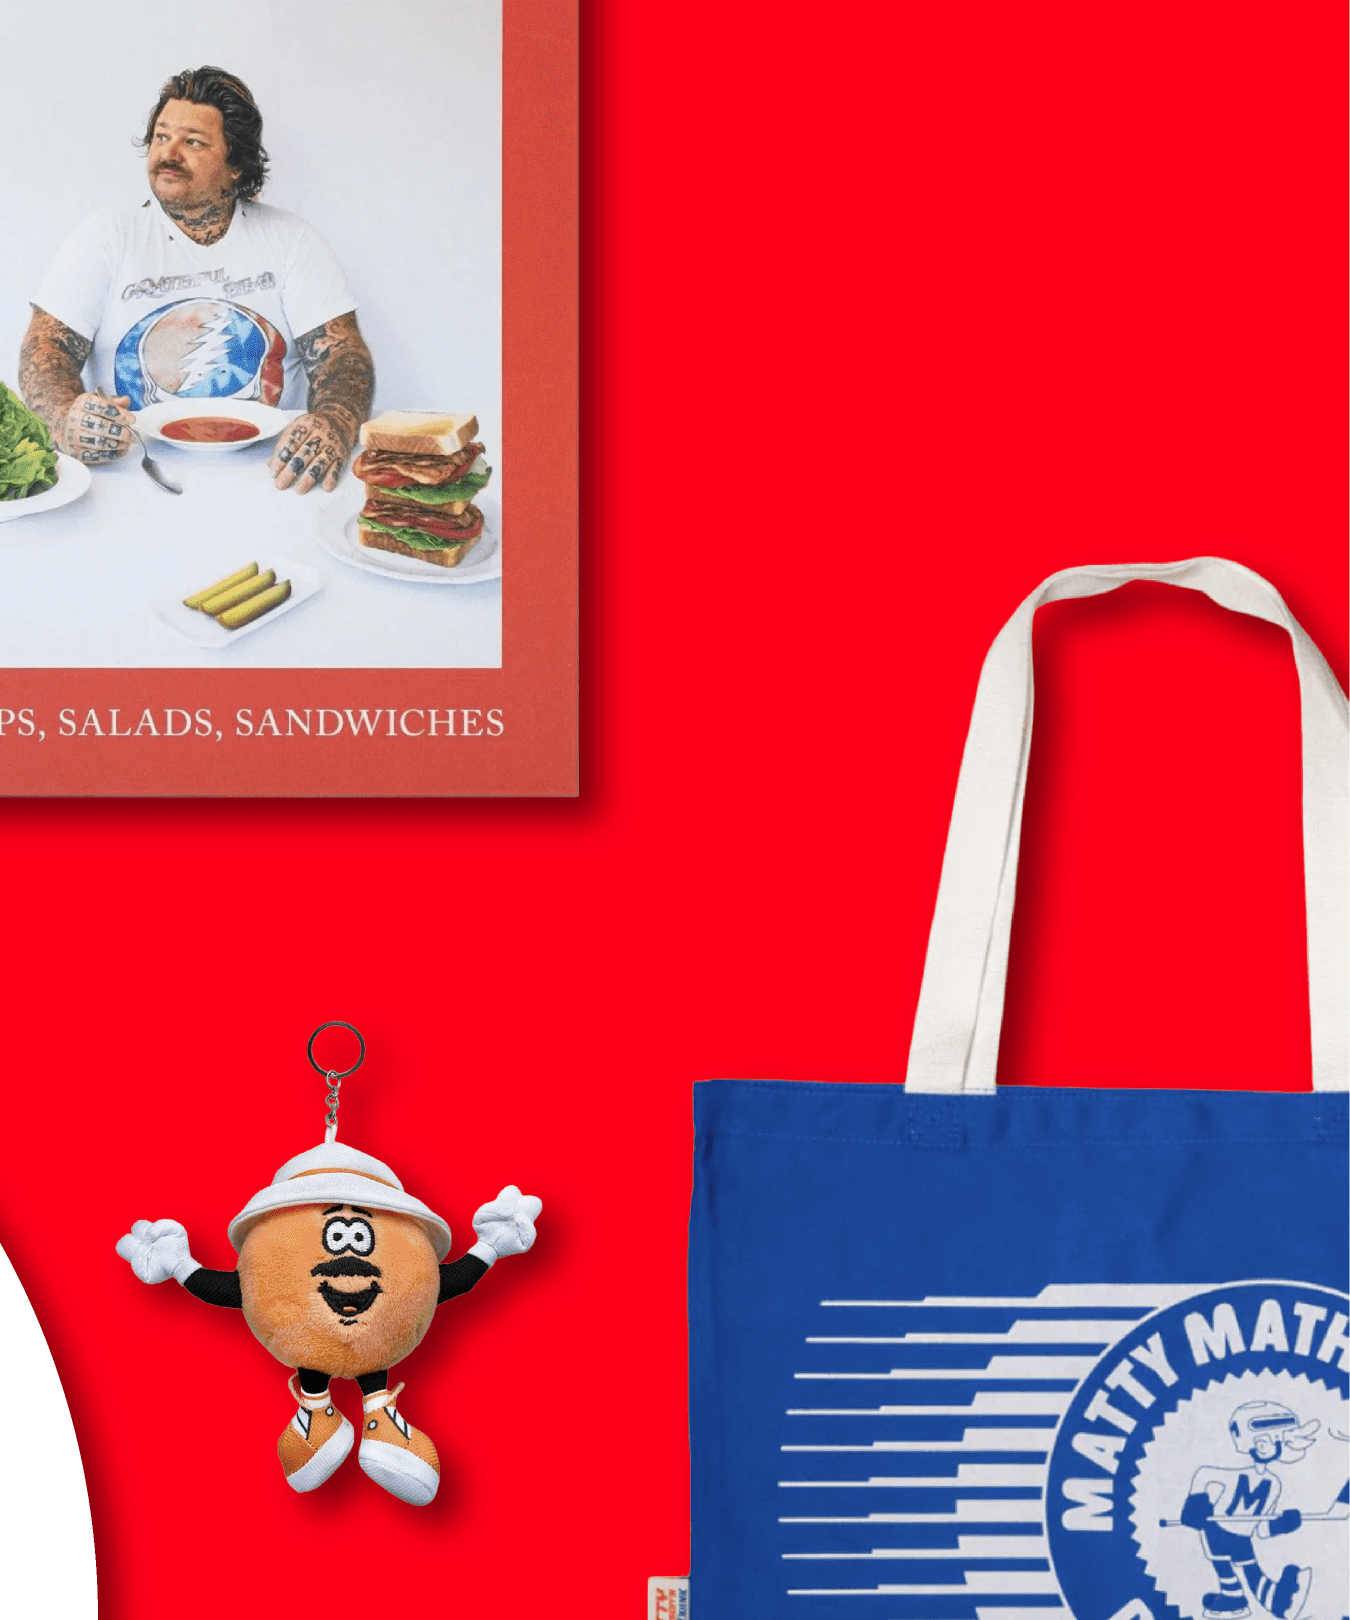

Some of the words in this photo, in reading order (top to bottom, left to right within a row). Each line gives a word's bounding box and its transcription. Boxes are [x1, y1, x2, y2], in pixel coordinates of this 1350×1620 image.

[58, 708, 223, 742] SALADS,
[235, 708, 505, 738] SANDWICHES
[1061, 1333, 1179, 1531] MATTY
